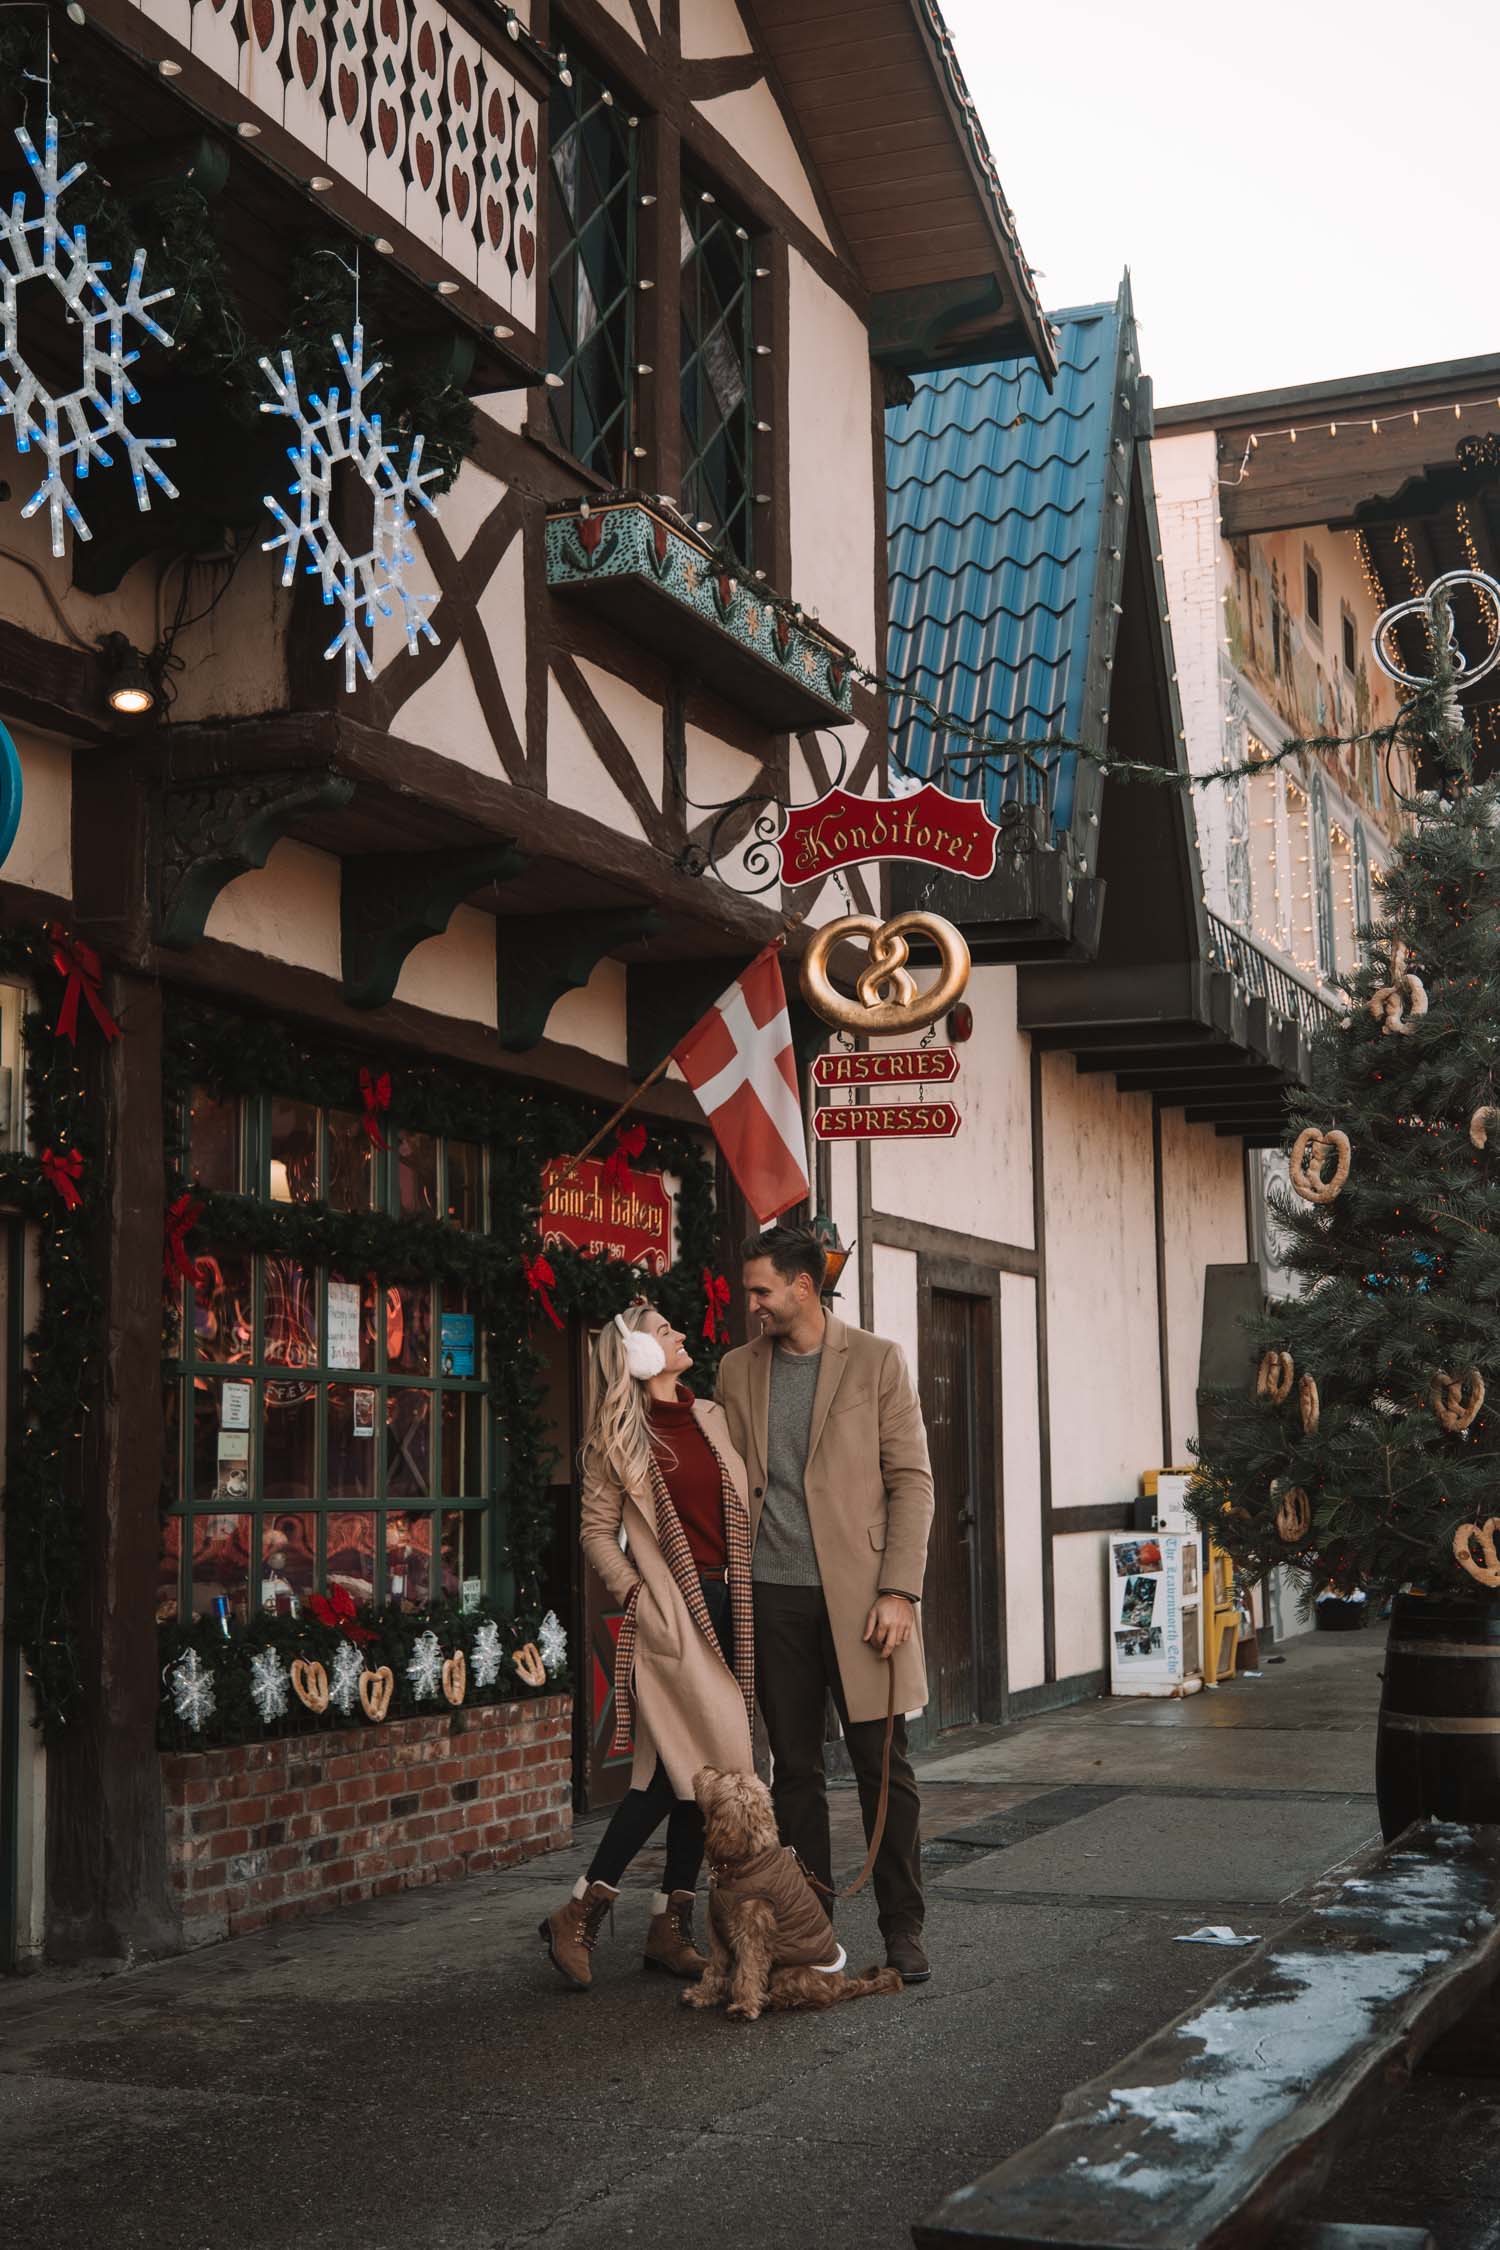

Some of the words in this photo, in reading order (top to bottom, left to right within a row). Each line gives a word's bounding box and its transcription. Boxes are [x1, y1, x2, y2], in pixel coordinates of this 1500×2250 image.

[795, 805, 979, 870] Konditorei
[821, 1052, 947, 1081] PASTRIES
[820, 1107, 947, 1132] ESPRESSO
[611, 1187, 663, 1237] Bakery
[1164, 1538, 1178, 1561] The
[1166, 1645, 1180, 1674] Echo
